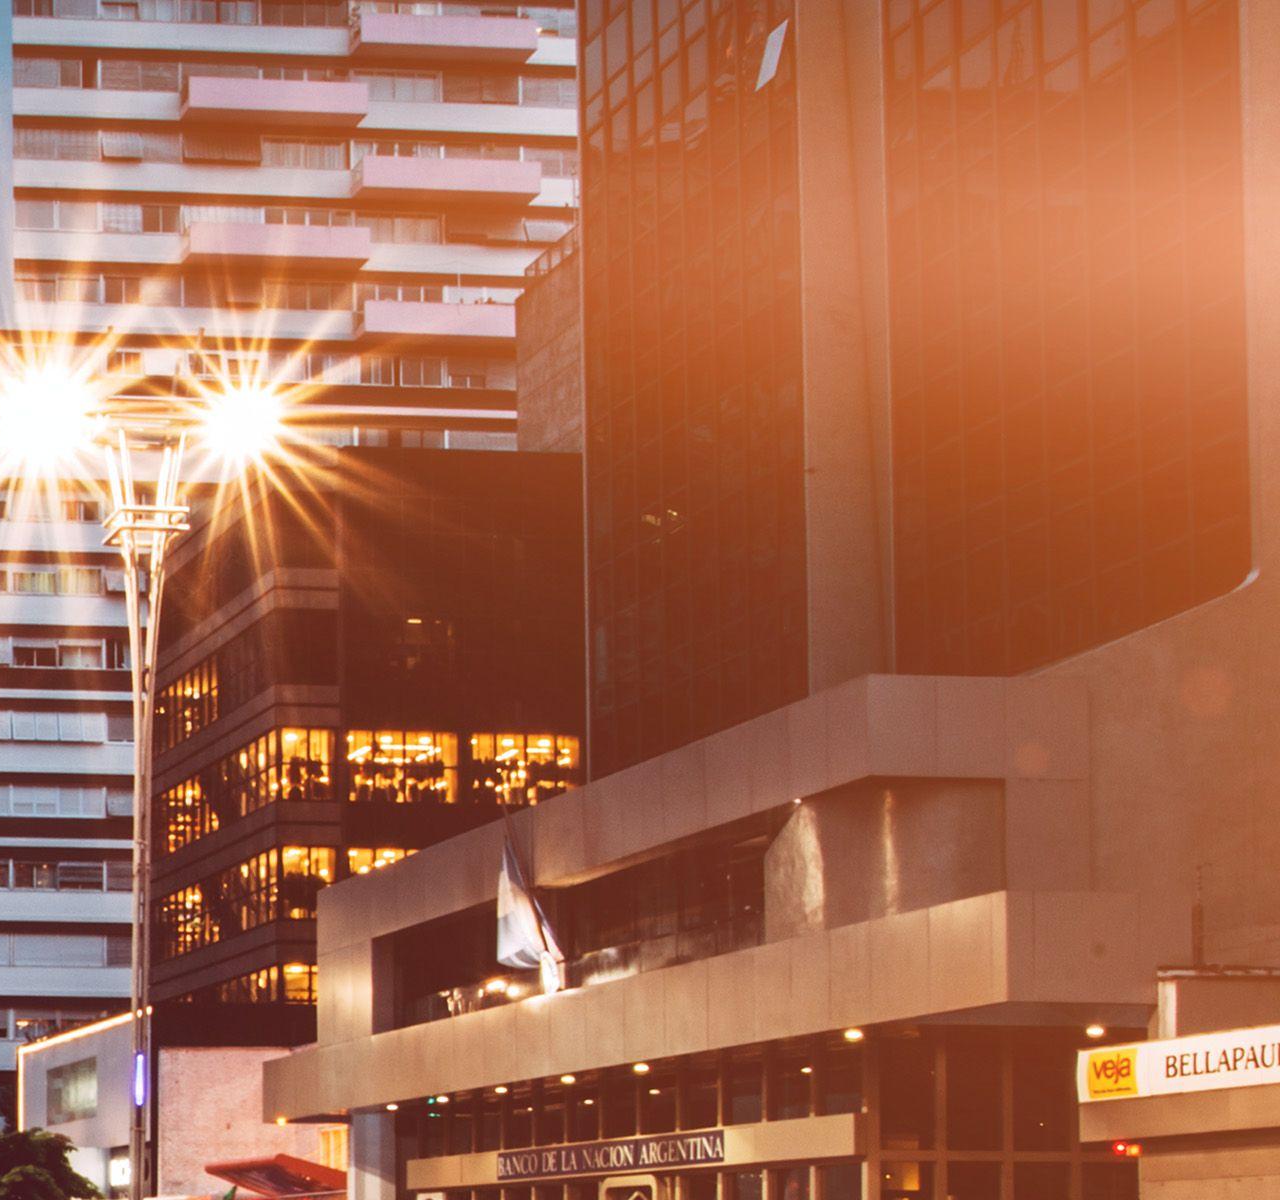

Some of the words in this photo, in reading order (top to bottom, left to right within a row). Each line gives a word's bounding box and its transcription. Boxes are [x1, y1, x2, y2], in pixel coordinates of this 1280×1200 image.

[1093, 1054, 1131, 1084] veja
[1165, 1043, 1280, 1078] BELLAPAU
[498, 1153, 538, 1176] BANCO
[542, 1151, 557, 1172] DE
[561, 1150, 577, 1171] LA
[582, 1144, 634, 1169] NACION
[639, 1136, 723, 1165] ARGENTINA
